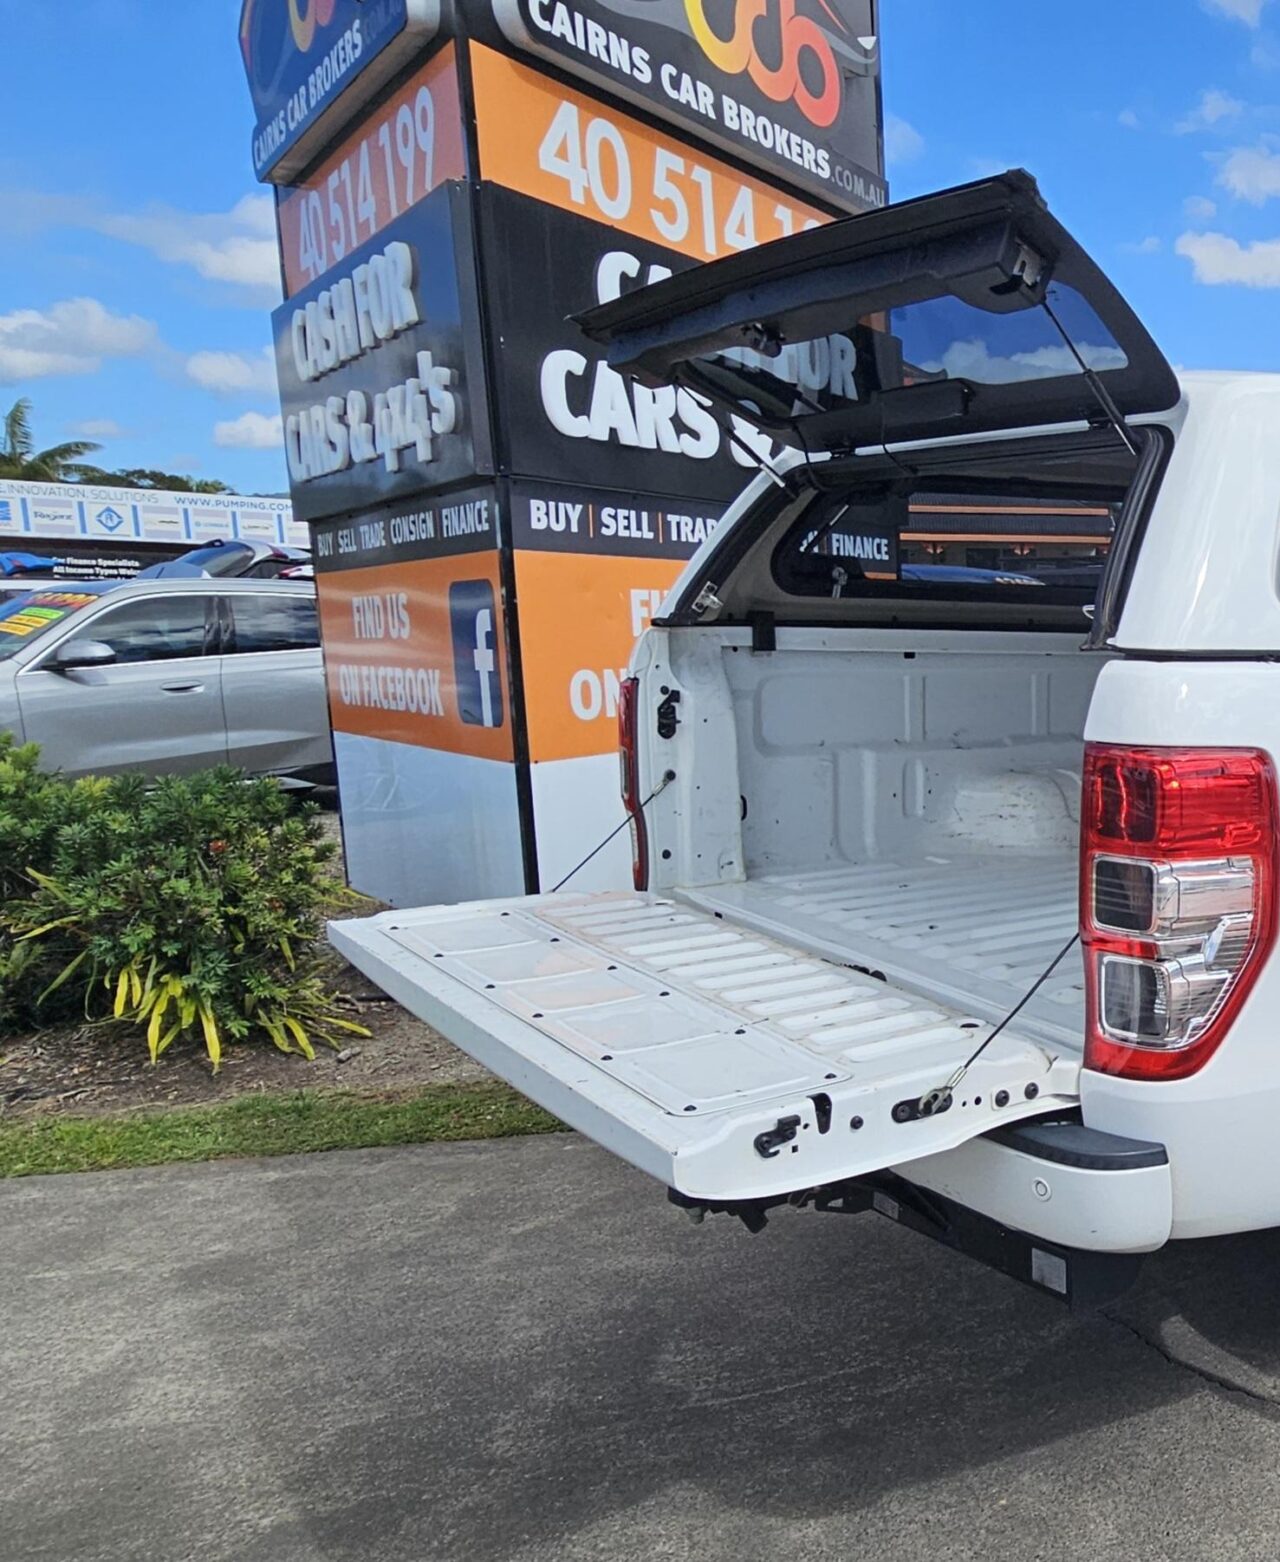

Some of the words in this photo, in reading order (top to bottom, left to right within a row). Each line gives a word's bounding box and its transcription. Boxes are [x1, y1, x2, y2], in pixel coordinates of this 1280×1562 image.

[529, 0, 652, 83] CAIRNS
[661, 63, 716, 120] CAR
[252, 117, 286, 169] CAIRNS
[287, 86, 306, 132] CAR
[300, 190, 325, 281] 40
[328, 140, 375, 260] 514
[378, 86, 434, 219] 199
[538, 101, 632, 220] 40
[650, 146, 759, 256] 514
[292, 278, 361, 382] CASH
[352, 241, 419, 349] FOR
[286, 396, 349, 482] CARS
[346, 390, 377, 463] &
[541, 349, 720, 459] CARS
[90, 489, 159, 504] SOLUTIONS
[317, 531, 333, 557] BUY
[338, 527, 357, 554] SELL
[360, 521, 386, 550] TRADE
[390, 511, 435, 544] CONSIGN
[441, 500, 490, 538] FINANCE
[530, 499, 584, 533] BUY
[600, 507, 654, 539] SELL
[832, 533, 889, 560] FINANCE
[352, 595, 384, 639] FIND
[386, 592, 410, 640] US
[339, 664, 360, 706] ON
[361, 665, 444, 716] FACEBOOK
